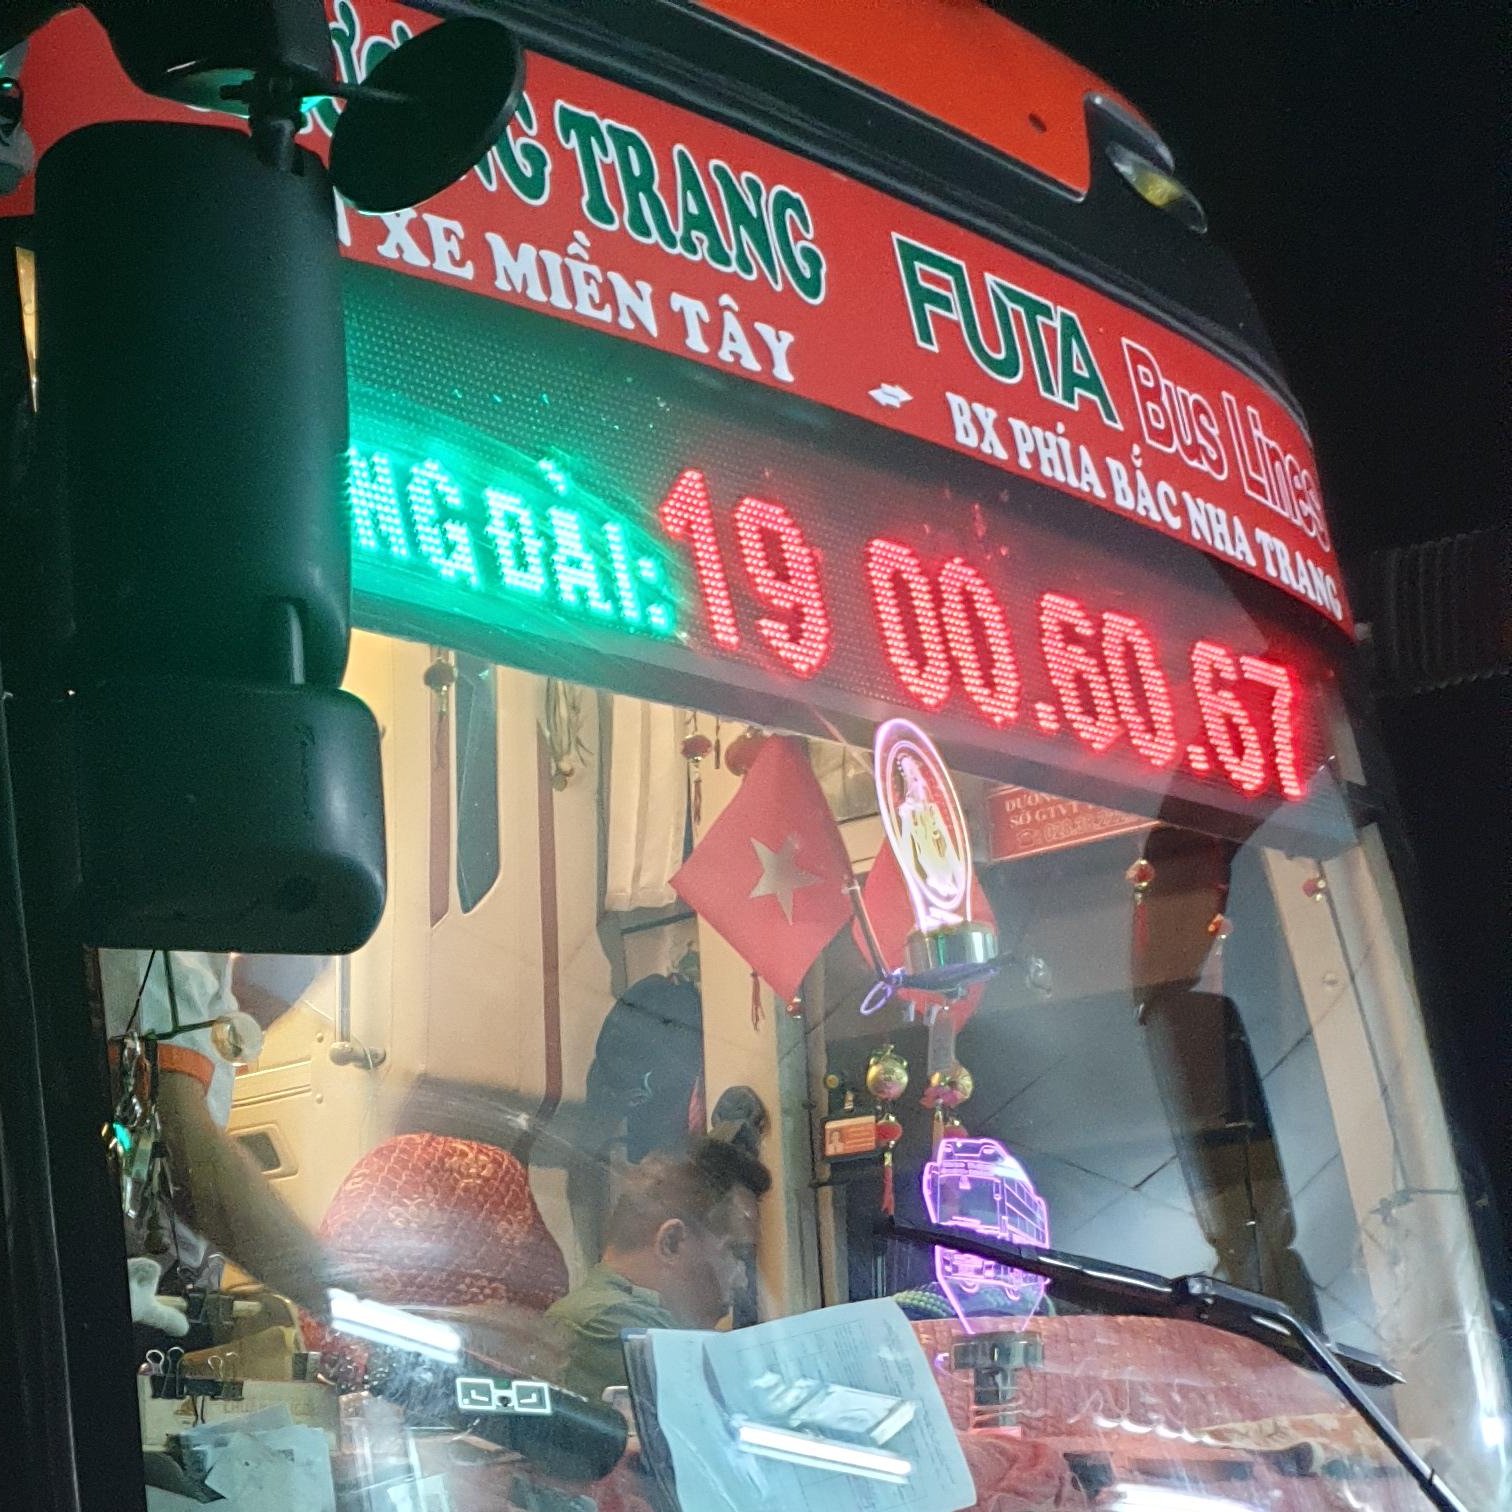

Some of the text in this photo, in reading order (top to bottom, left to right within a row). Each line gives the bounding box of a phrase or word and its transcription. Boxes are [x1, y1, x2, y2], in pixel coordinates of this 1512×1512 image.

[376, 207, 474, 281] XE
[484, 230, 658, 338] MIỀN
[670, 293, 795, 383] TÂY
[554, 98, 826, 303] TRANG
[891, 231, 1124, 431] FUTA
[347, 446, 482, 592] NG
[660, 467, 832, 681] 19
[945, 391, 1009, 460] BX
[1181, 491, 1257, 567] NHA
[1254, 527, 1343, 622] TRANG
